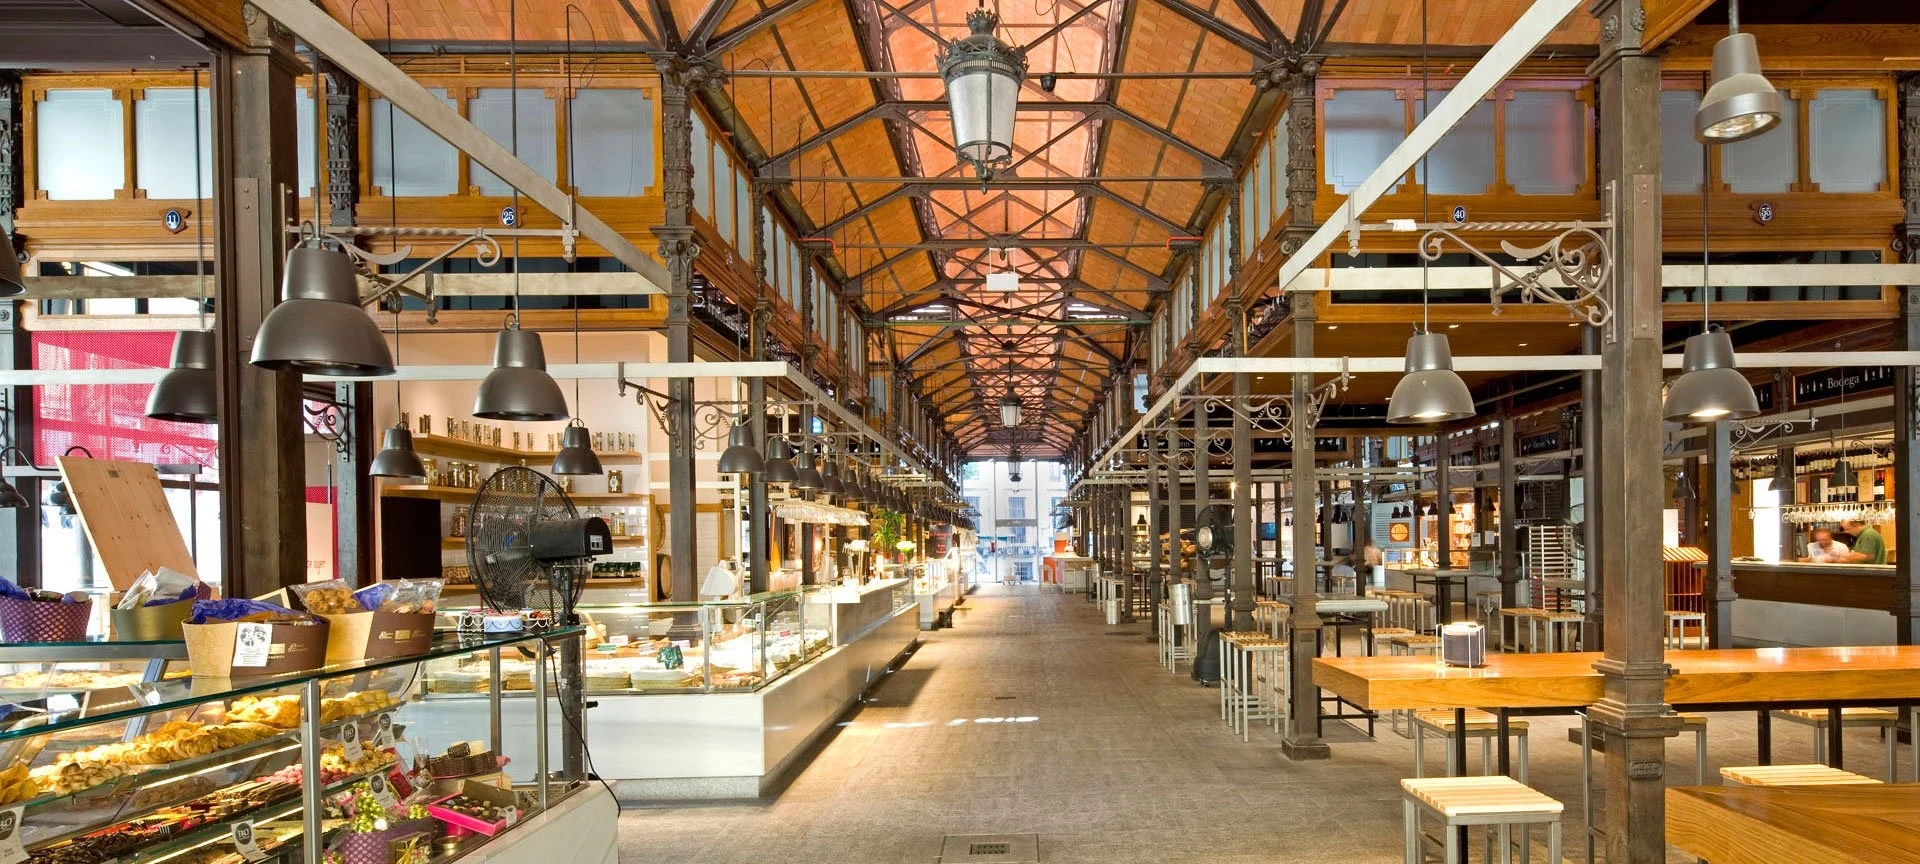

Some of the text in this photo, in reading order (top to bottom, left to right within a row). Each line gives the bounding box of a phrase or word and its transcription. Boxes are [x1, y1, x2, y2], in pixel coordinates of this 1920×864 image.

[503, 211, 514, 220] 25
[1454, 209, 1465, 219] 40
[1827, 375, 1860, 389] Bodega
